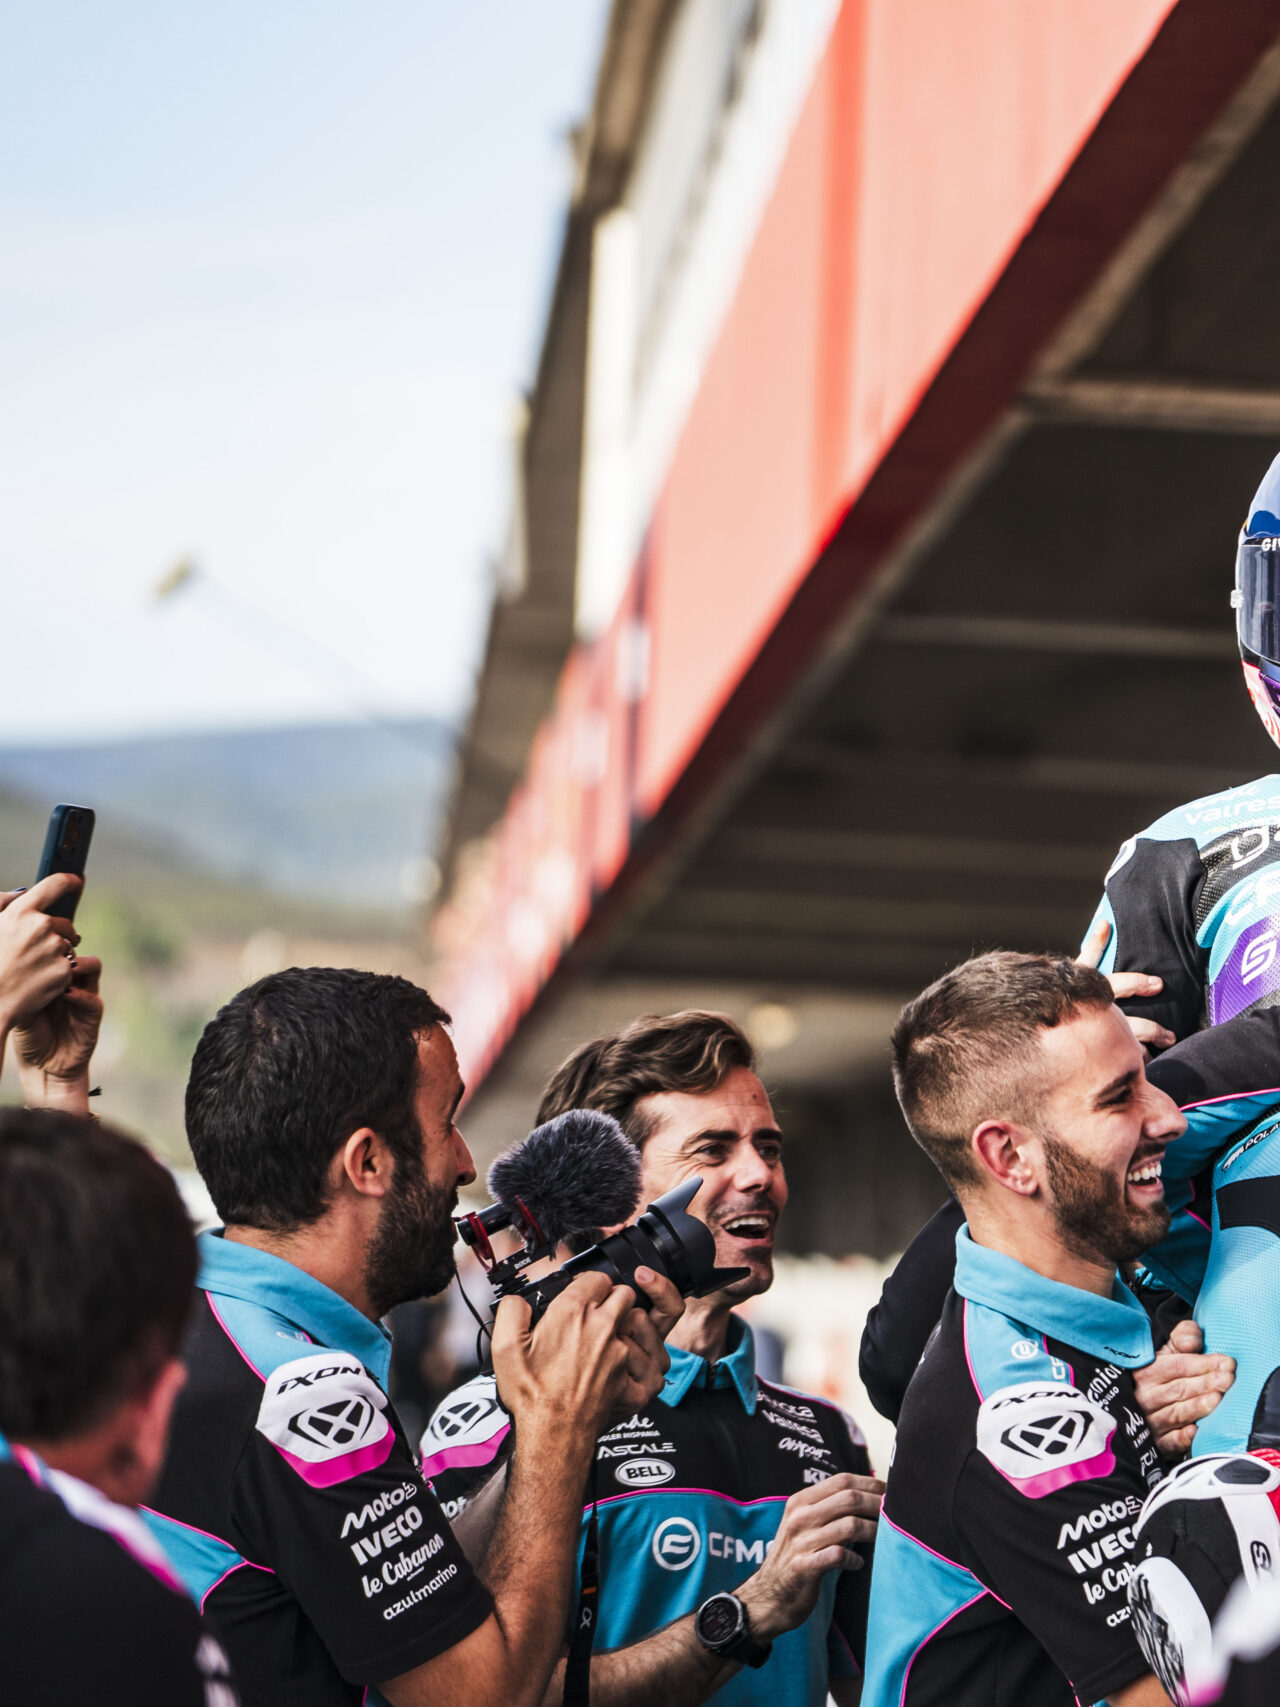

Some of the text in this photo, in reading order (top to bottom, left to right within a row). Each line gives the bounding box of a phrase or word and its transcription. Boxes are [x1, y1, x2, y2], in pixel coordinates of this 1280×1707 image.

[277, 1366, 362, 1395] IXON
[991, 1390, 1081, 1411] IXON
[626, 1465, 667, 1479] BELL
[803, 1467, 833, 1484] KT
[350, 1505, 423, 1566] IVECO
[708, 1531, 775, 1565] CFM
[361, 1574, 384, 1599] le
[382, 1533, 445, 1586] Cabanon
[383, 1563, 458, 1621] azulmarino
[1083, 1581, 1106, 1605] le
